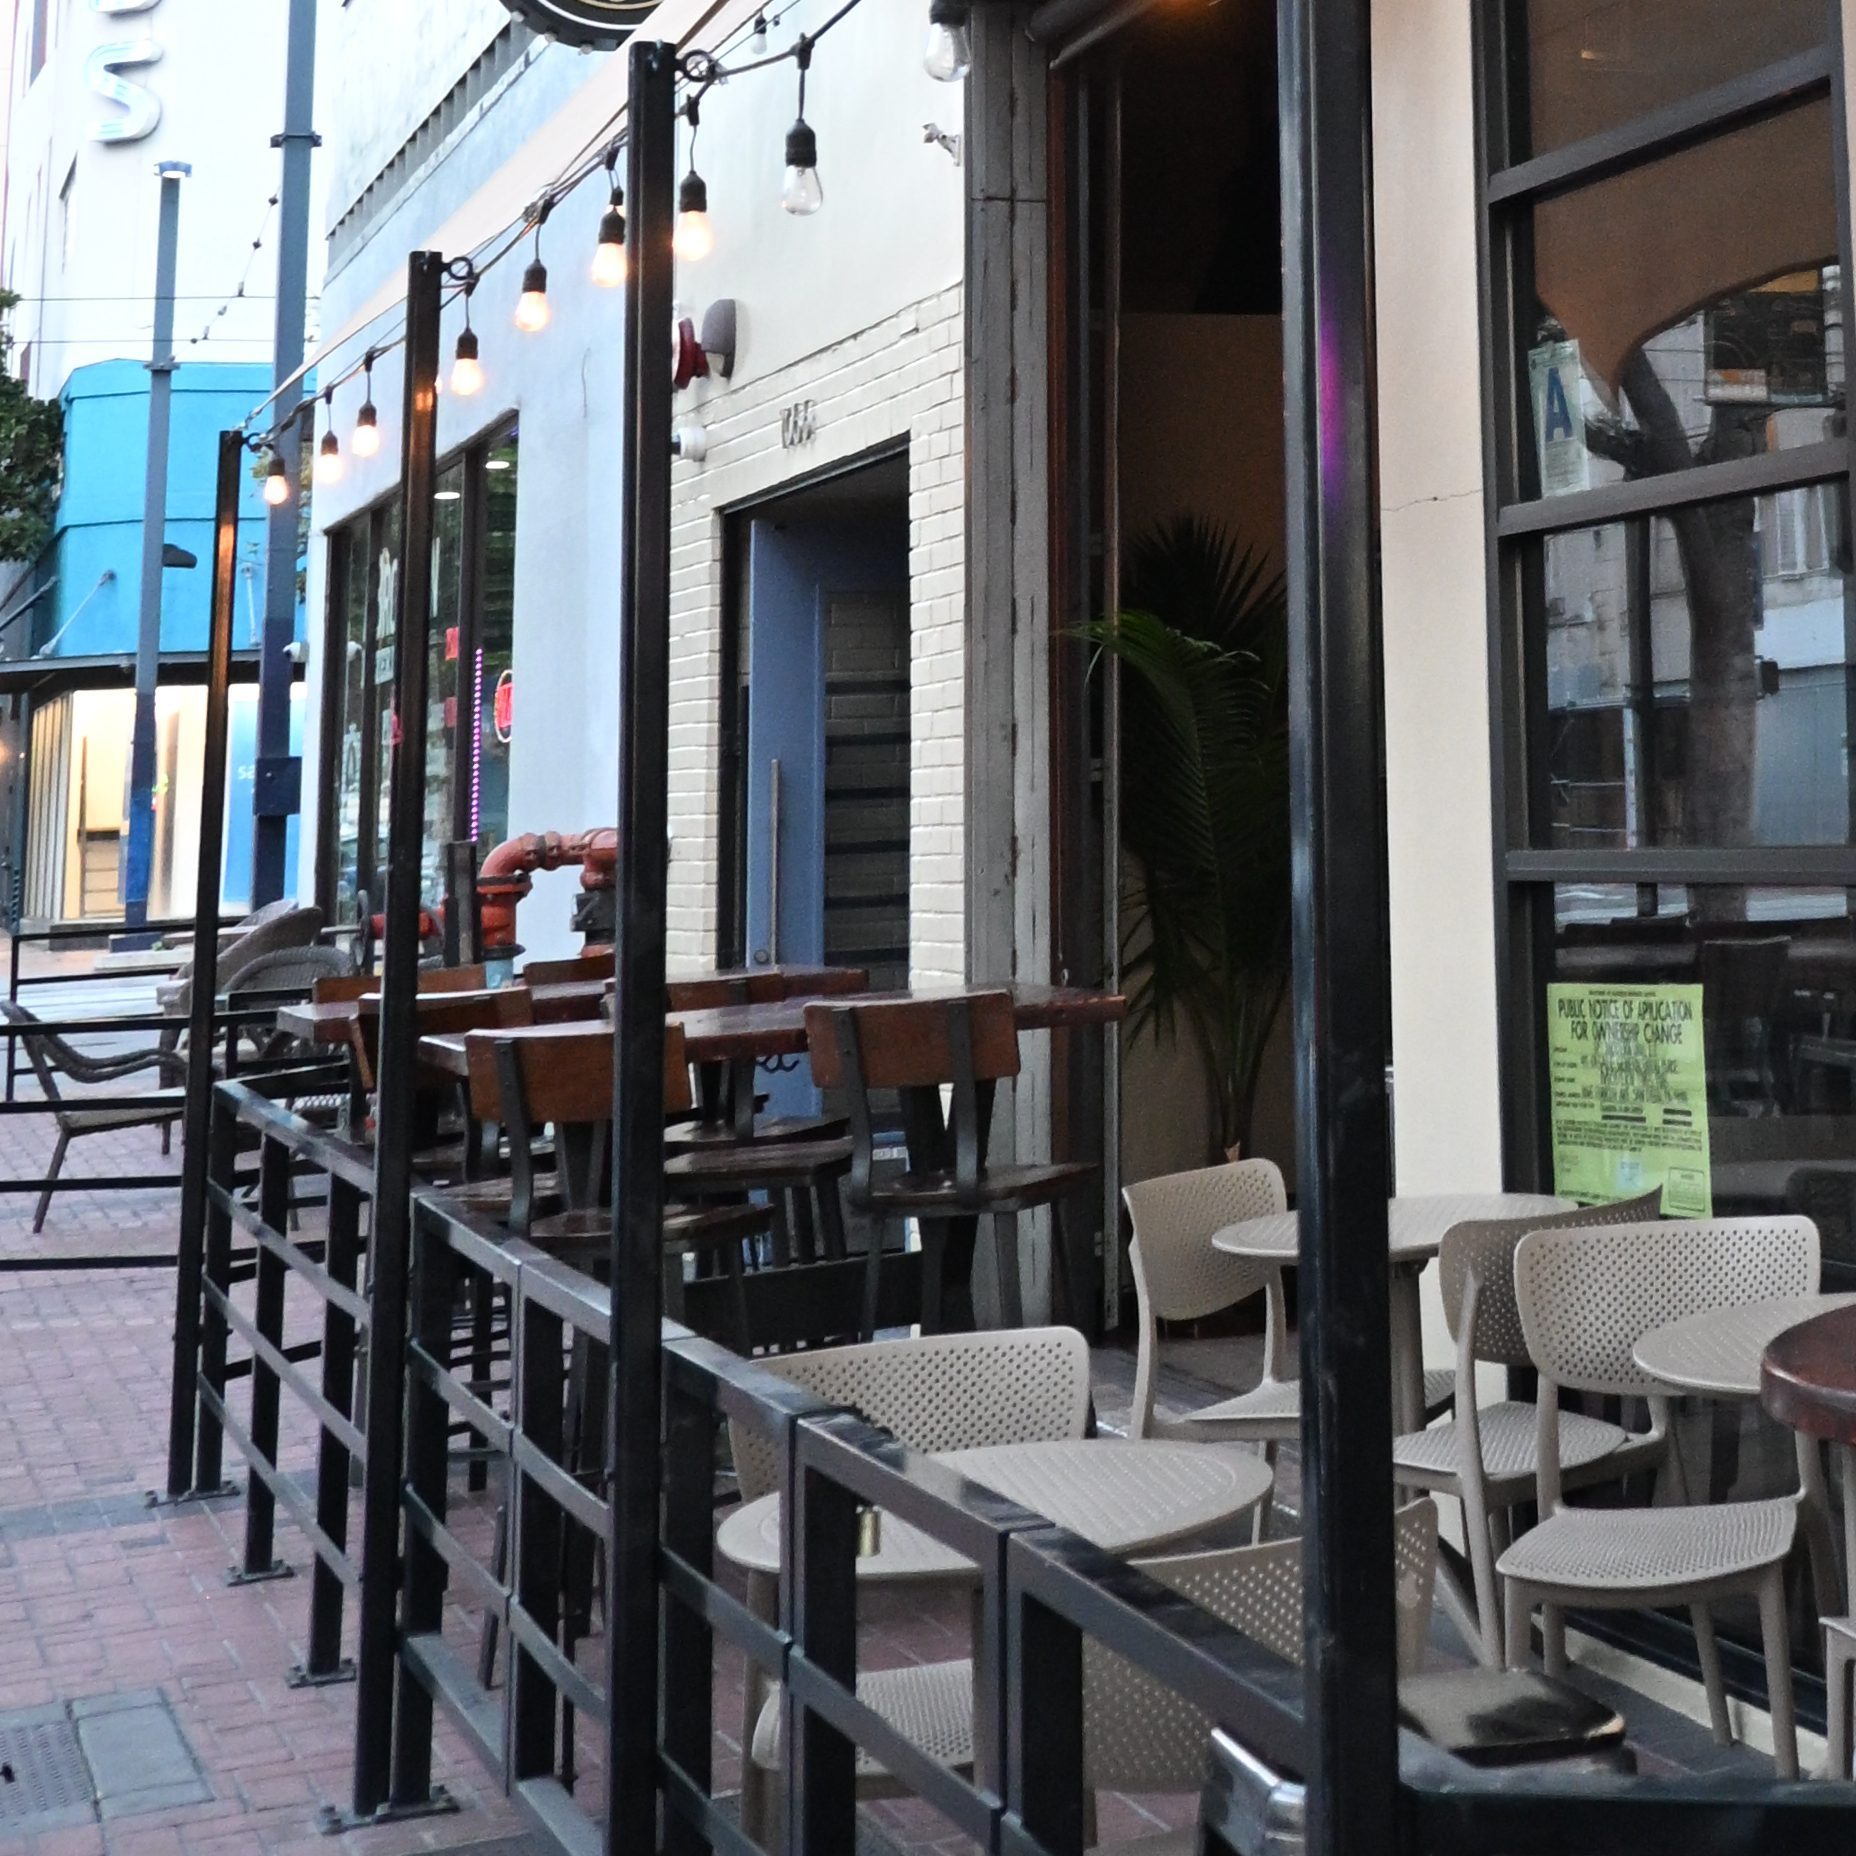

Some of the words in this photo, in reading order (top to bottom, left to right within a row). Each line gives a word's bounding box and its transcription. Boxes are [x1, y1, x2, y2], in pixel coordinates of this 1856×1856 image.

[1544, 366, 1573, 443] A
[1557, 998, 1585, 1019] PUBLIC
[1588, 999, 1620, 1019] NOTICE
[1622, 999, 1633, 1019] OF
[1637, 1000, 1692, 1021] APPLICATION
[1570, 1021, 1588, 1040] FOR
[1591, 1021, 1640, 1041] OWNERSHIP
[1643, 1023, 1683, 1044] CHANGE
